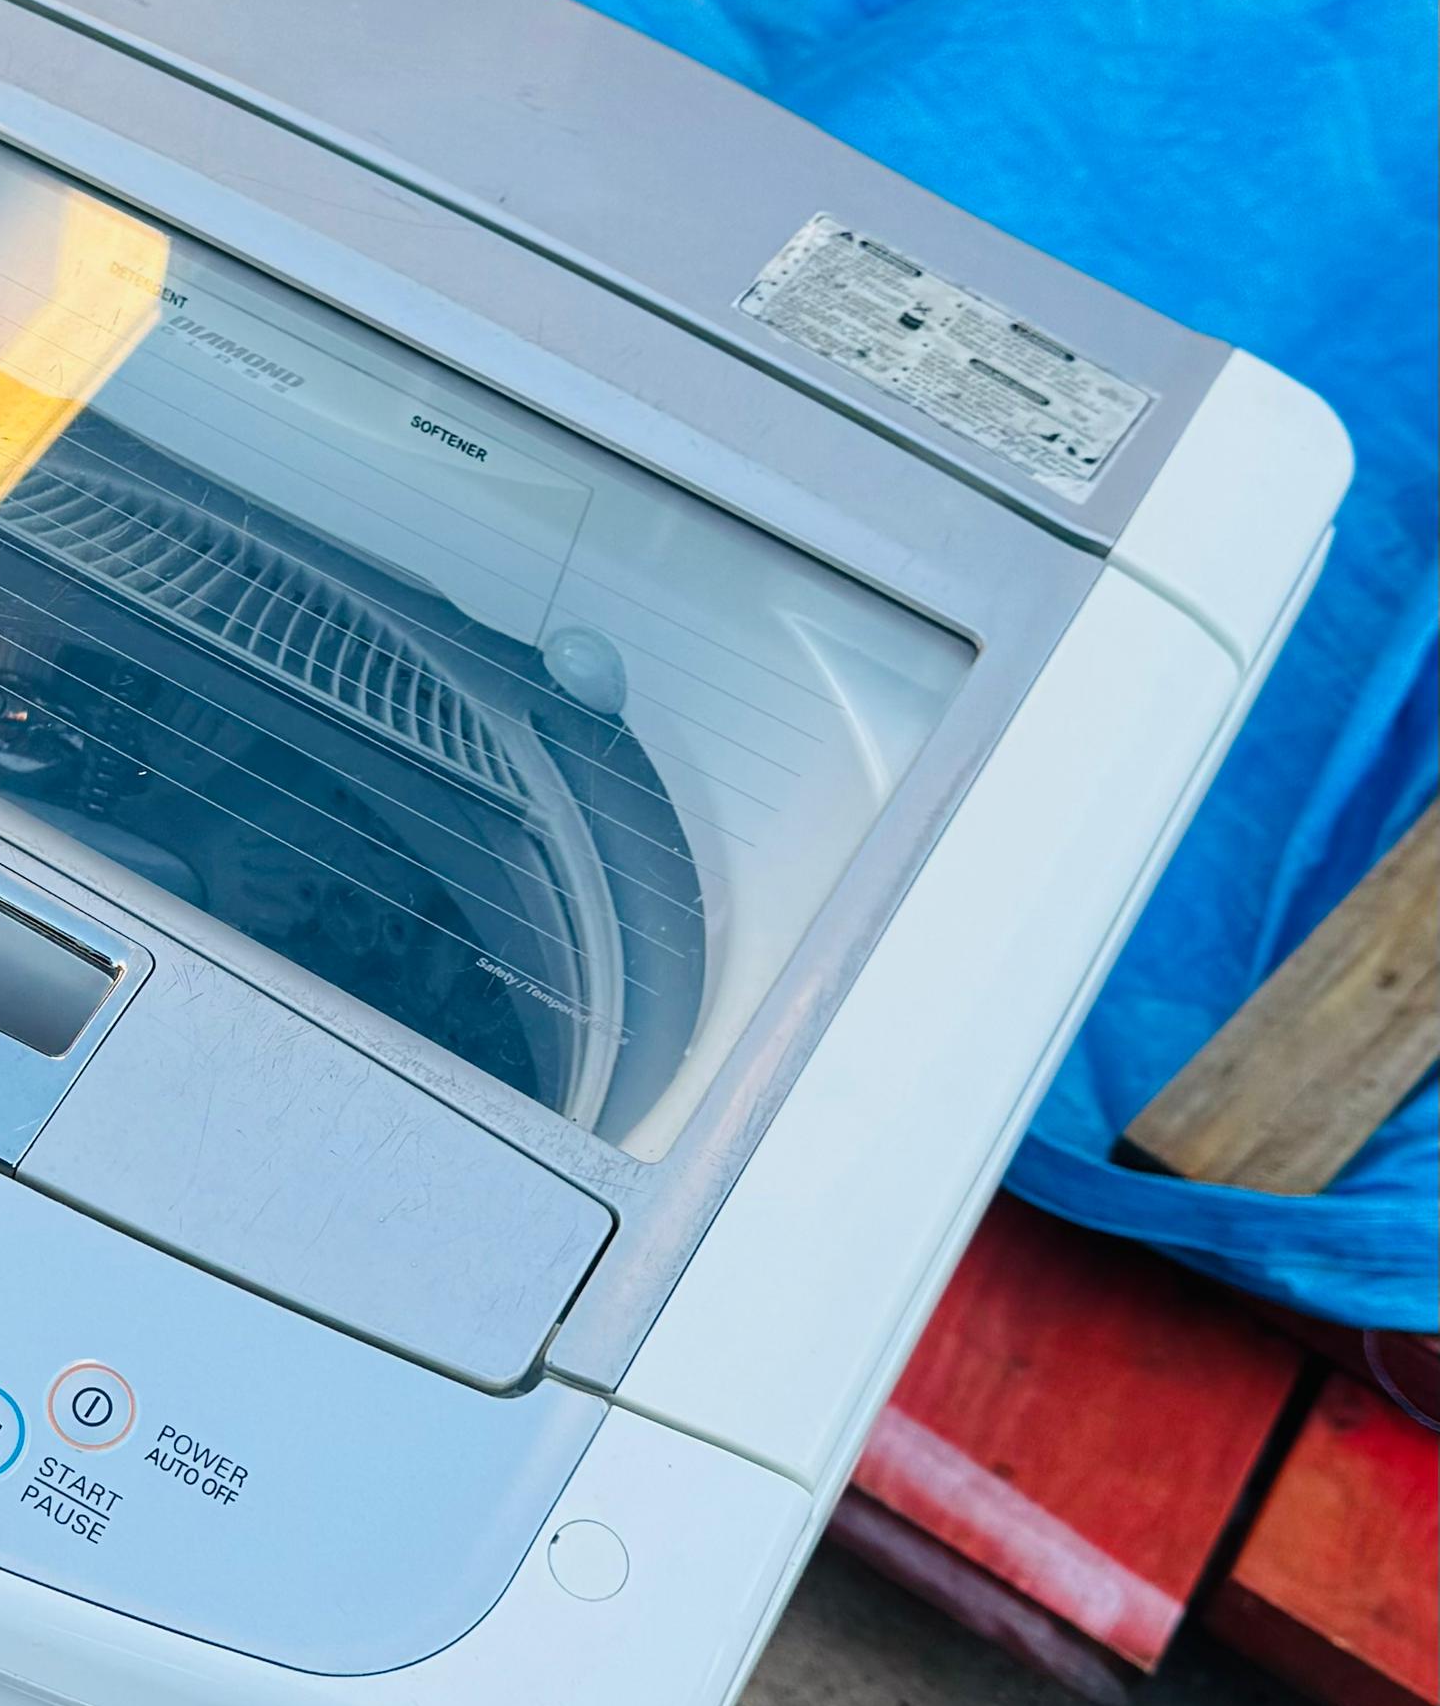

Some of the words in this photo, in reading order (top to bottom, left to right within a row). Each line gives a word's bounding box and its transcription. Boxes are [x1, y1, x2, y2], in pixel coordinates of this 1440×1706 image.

[168, 315, 306, 388] DIAMOND
[410, 415, 488, 462] SOFTENER
[475, 957, 519, 987] Safety
[38, 1456, 124, 1512] START
[144, 1447, 200, 1486] AUTO
[201, 1477, 240, 1506] OFF
[157, 1424, 249, 1489] POWER
[20, 1484, 106, 1544] PAUSE
